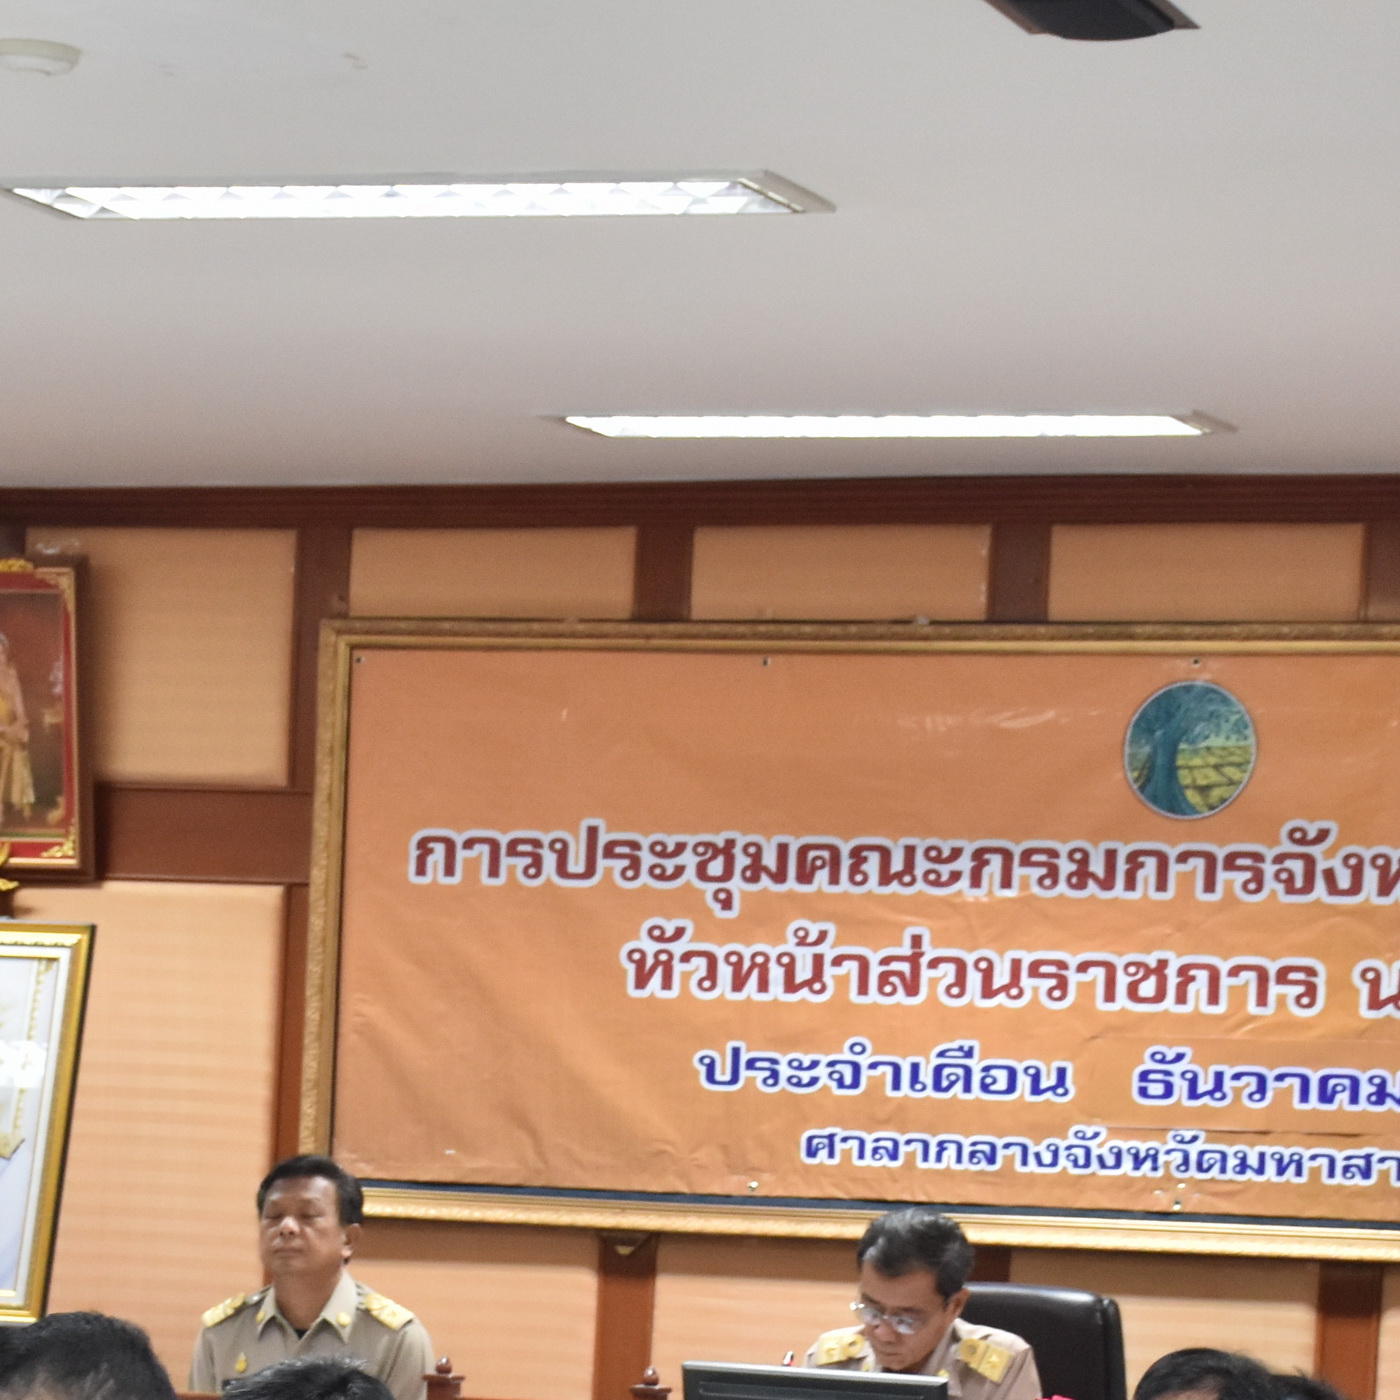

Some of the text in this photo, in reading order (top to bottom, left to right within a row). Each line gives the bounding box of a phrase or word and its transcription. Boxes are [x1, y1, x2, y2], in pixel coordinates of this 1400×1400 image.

[626, 924, 1321, 1009] หัวหน้าส่วนราชการ
[699, 1041, 1069, 1098] ประจำเดือน
